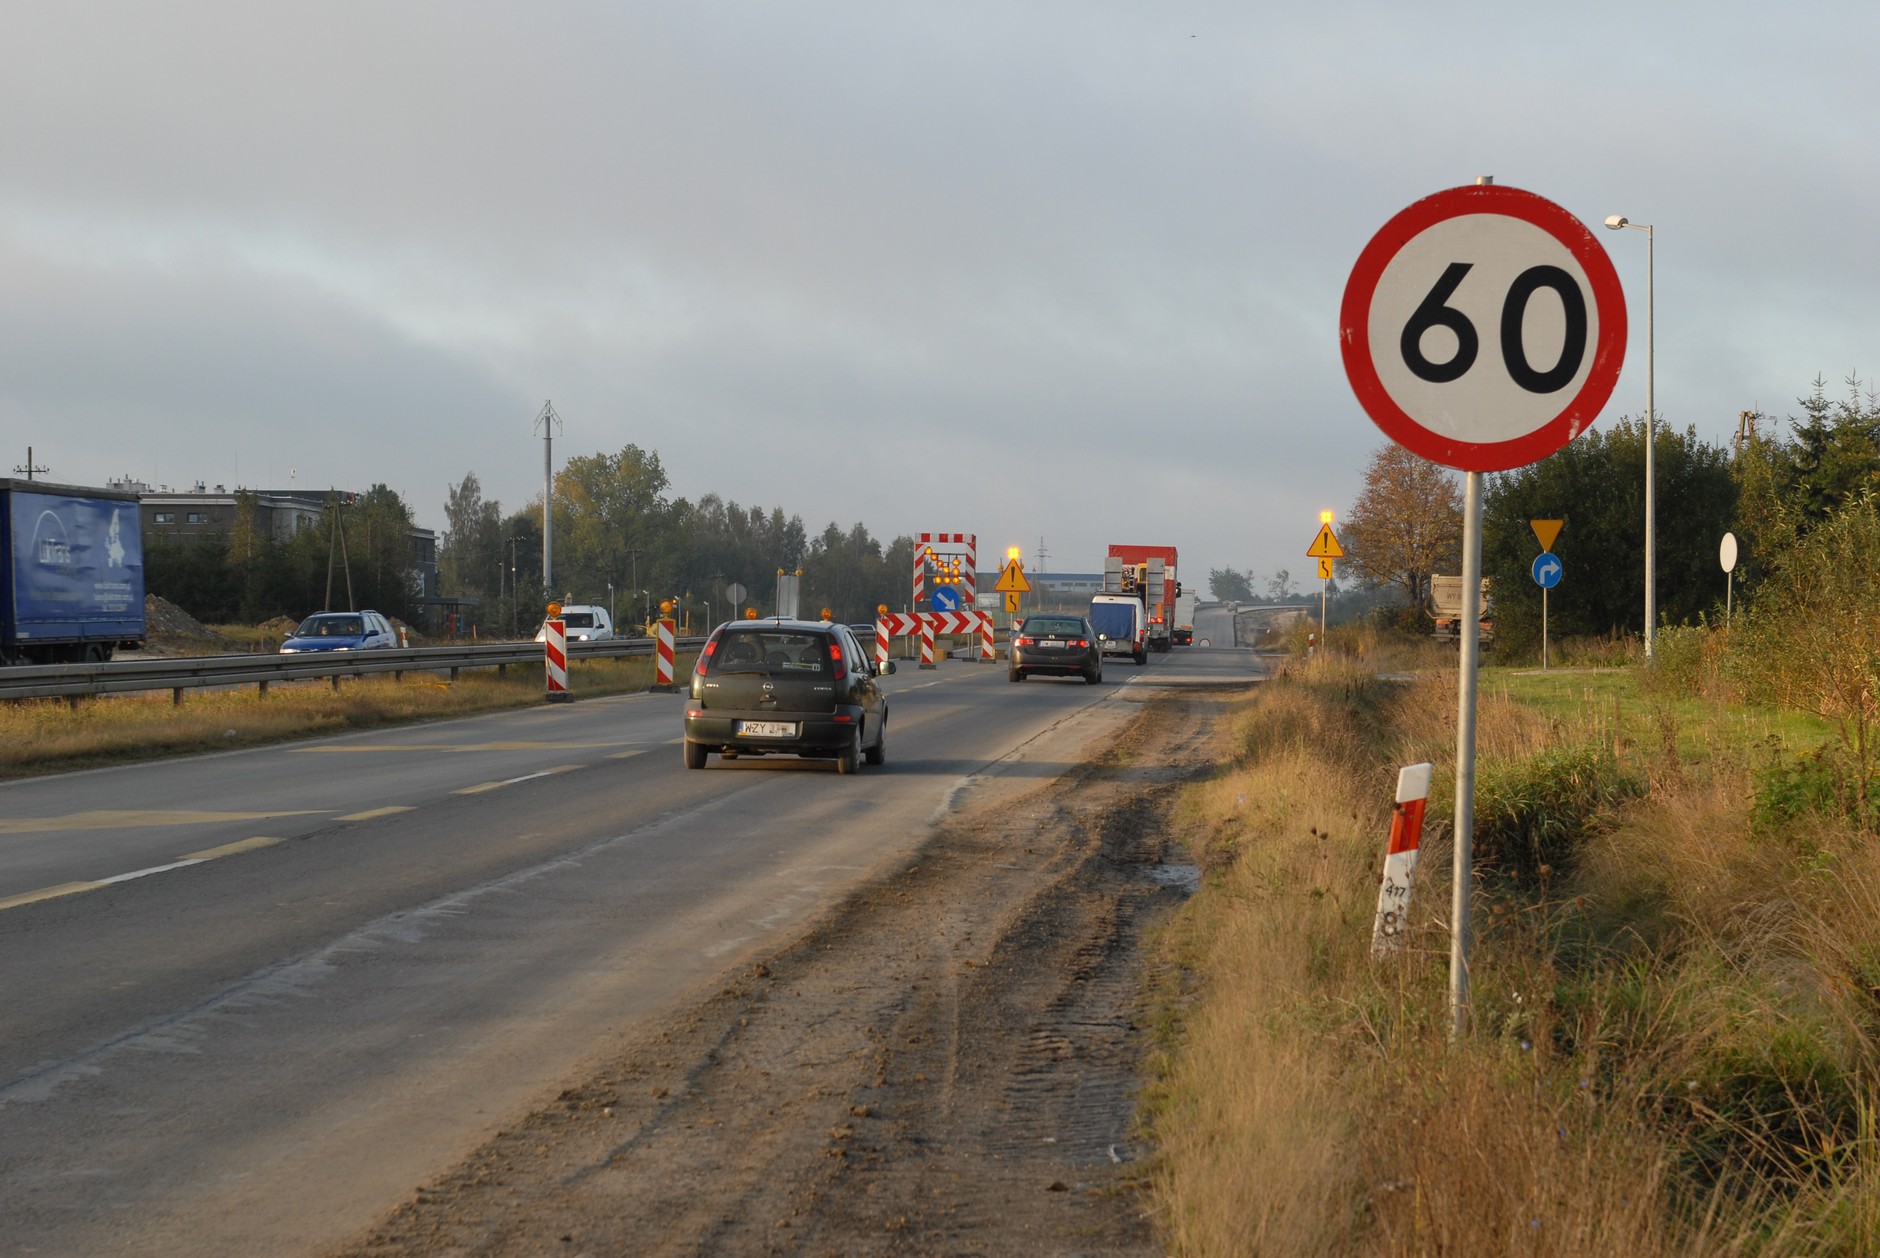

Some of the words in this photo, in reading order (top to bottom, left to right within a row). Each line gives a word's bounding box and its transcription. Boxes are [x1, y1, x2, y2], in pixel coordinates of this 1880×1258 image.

[1400, 262, 1588, 395] 60
[745, 723, 766, 734] WZY
[1385, 885, 1406, 897] 417
